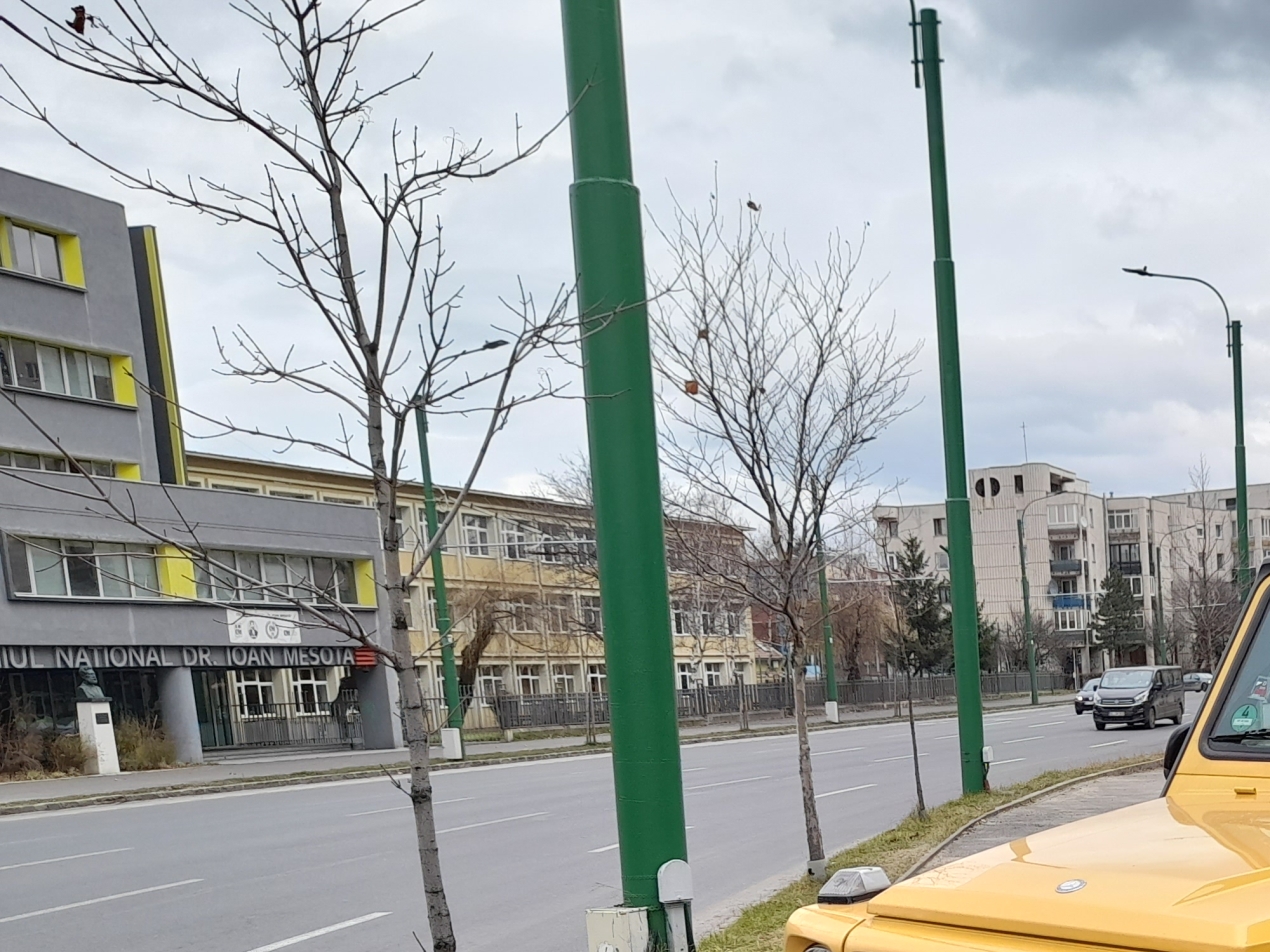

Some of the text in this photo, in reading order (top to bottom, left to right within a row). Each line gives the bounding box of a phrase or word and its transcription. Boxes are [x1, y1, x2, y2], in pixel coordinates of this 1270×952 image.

[0, 646, 44, 669] IUL
[55, 646, 174, 669] NATIONAL
[182, 646, 217, 667] DR.
[226, 646, 274, 667] IOAN
[1241, 705, 1250, 718] 4
